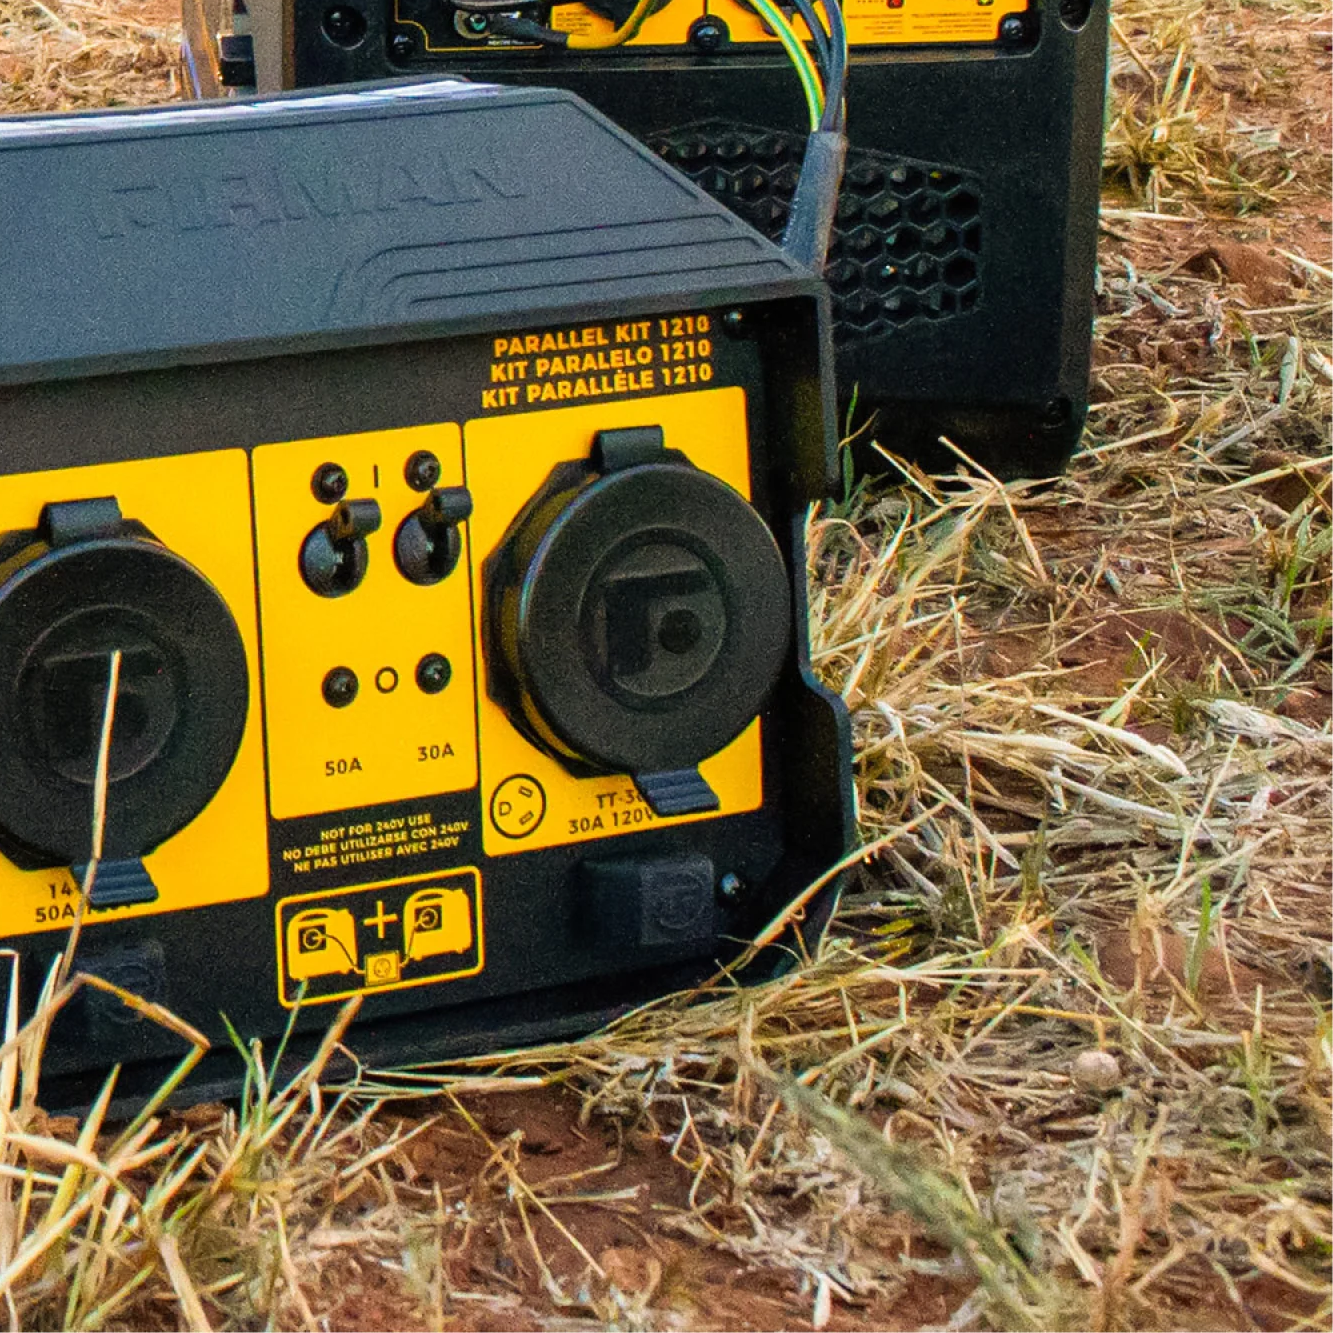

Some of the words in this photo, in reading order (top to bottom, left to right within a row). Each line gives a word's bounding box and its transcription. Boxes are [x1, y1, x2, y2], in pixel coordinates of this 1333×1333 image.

[493, 326, 609, 358] PARALLEL
[616, 321, 651, 343] KIT
[659, 314, 711, 338] 1210
[490, 361, 528, 383] KIT
[536, 346, 654, 378] PARALELO
[660, 338, 712, 362] 1210
[481, 386, 519, 409] KIT
[662, 362, 714, 386] 1210
[325, 757, 363, 777] 50A
[418, 742, 454, 762] 30A
[282, 849, 302, 862] NO
[304, 842, 337, 858] DEBE
[339, 829, 408, 852] UTILIZARSE
[410, 825, 438, 840] CON
[440, 821, 470, 836] 240V
[320, 826, 346, 841] NOT
[349, 822, 373, 836] FOR
[376, 817, 405, 832] 240V
[408, 812, 432, 826] USE
[567, 814, 604, 835] 30A
[293, 862, 311, 874] NE
[313, 854, 338, 870] PAS
[340, 845, 394, 865] UTILISER
[396, 840, 429, 857] AVEC
[430, 835, 460, 851] 240V
[35, 903, 76, 924] 50A
